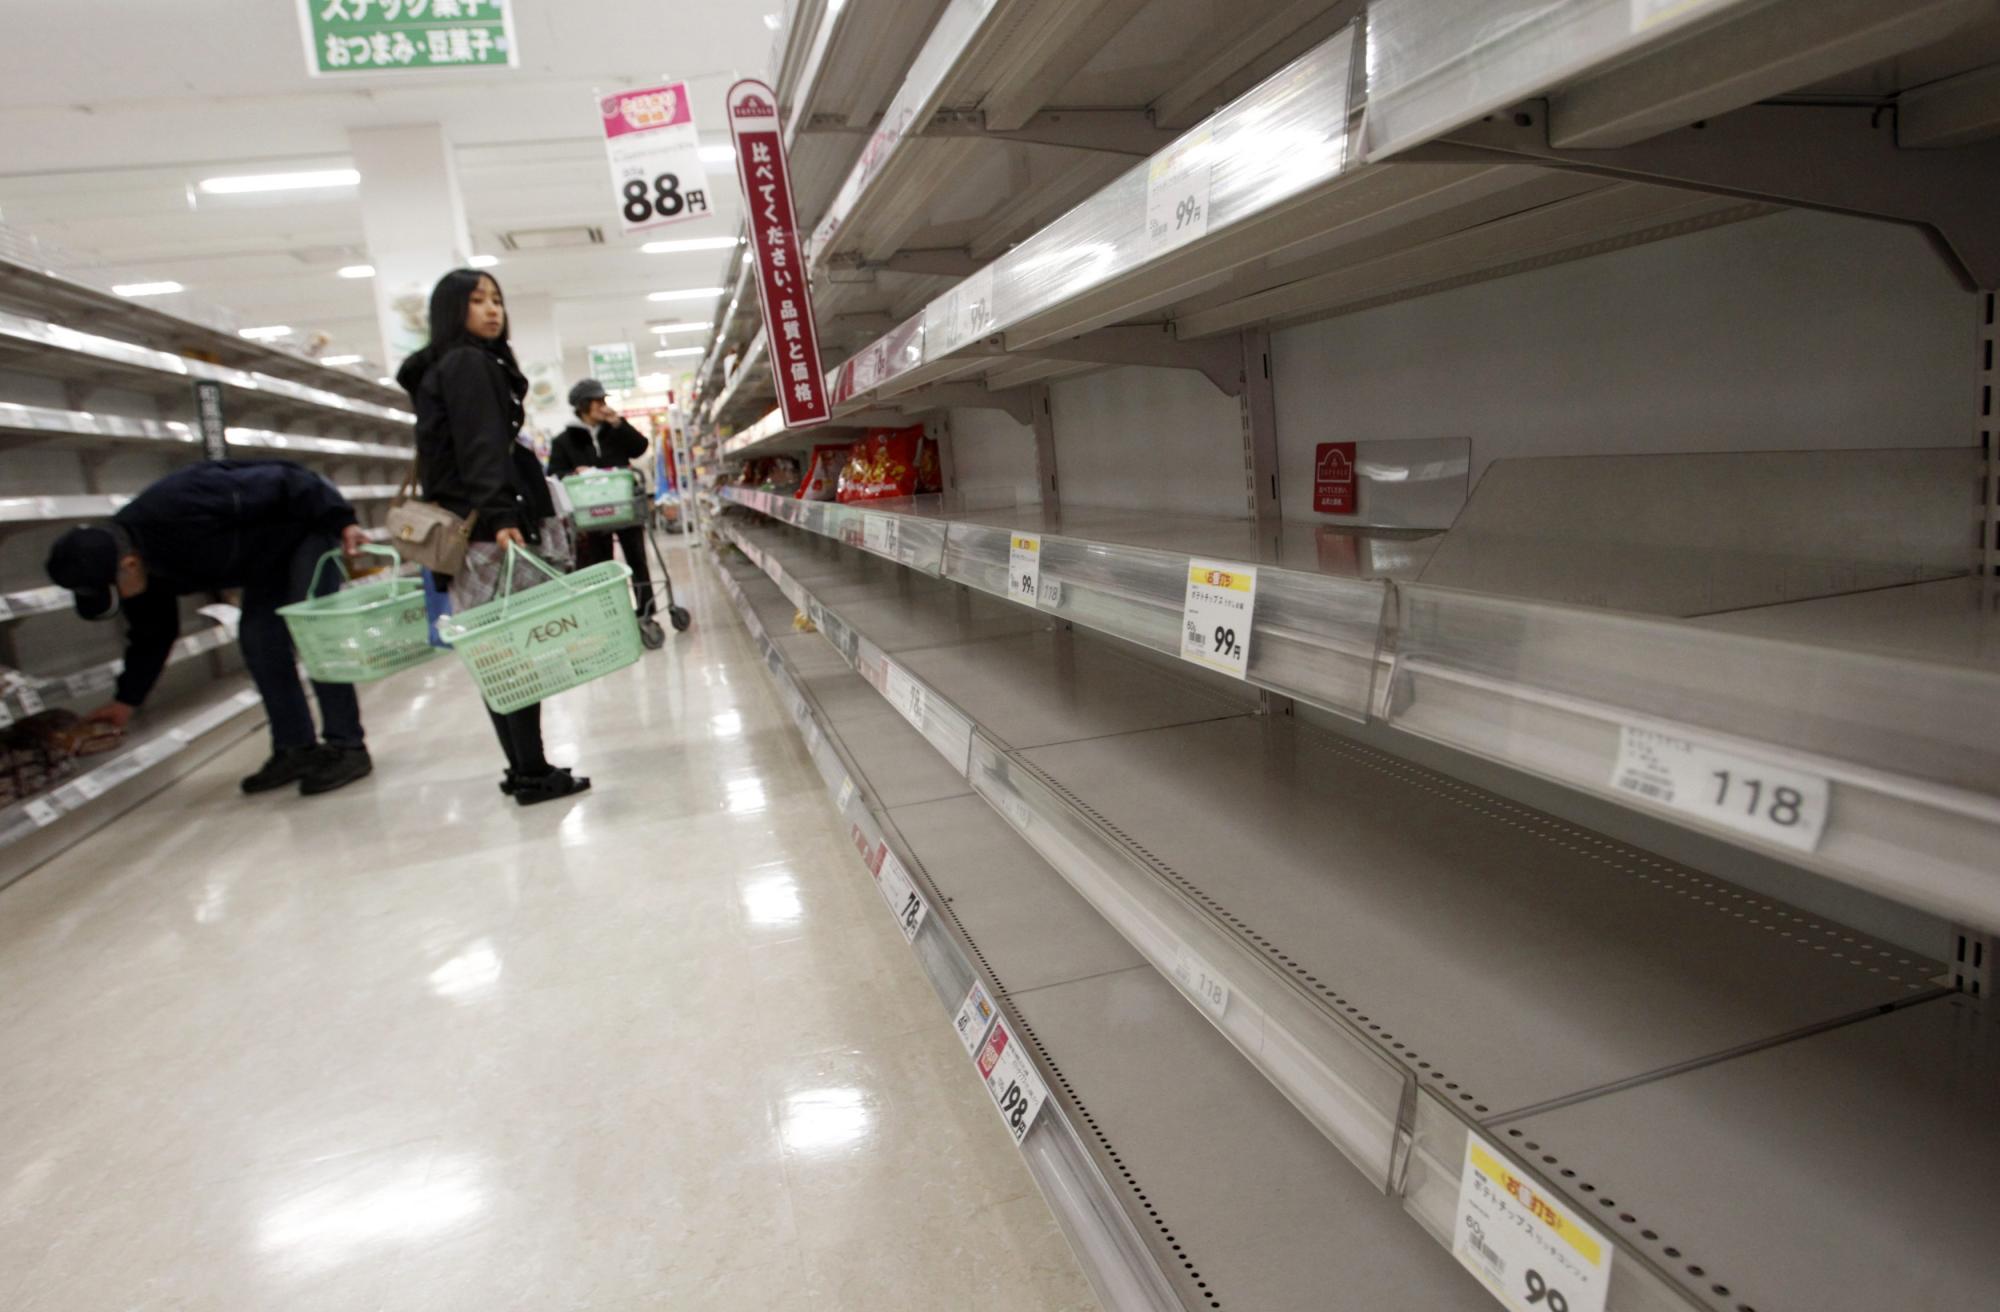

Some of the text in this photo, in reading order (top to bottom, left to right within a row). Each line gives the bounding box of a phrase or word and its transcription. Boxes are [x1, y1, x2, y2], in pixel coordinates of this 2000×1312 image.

[623, 173, 707, 223] 88円
[1214, 626, 1241, 661] 99円
[1711, 769, 1803, 826] 118
[1201, 974, 1221, 1004] 118
